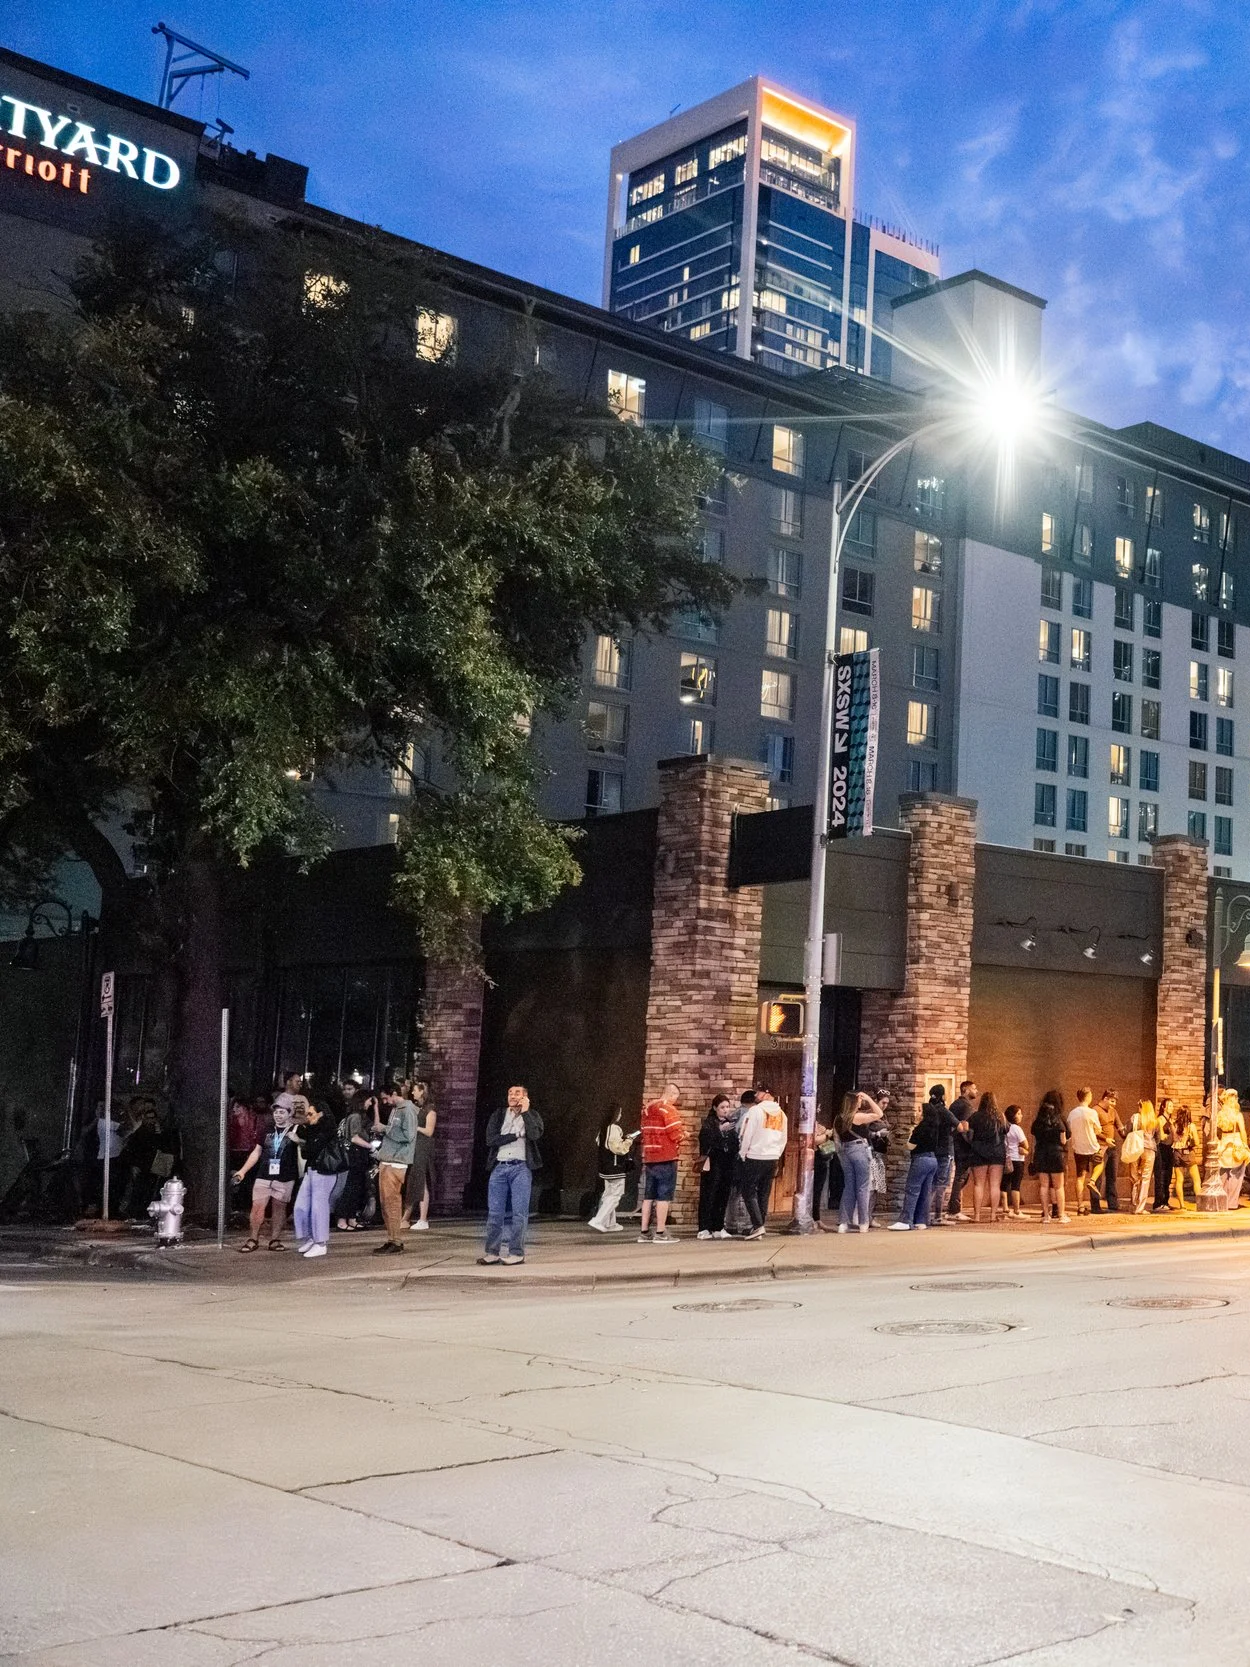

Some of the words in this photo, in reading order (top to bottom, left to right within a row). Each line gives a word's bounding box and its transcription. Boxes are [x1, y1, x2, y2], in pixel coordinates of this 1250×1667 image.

[0, 94, 181, 190] TYARD
[0, 143, 91, 194] riott
[835, 665, 852, 730] SXSW
[832, 765, 848, 827] 2024
